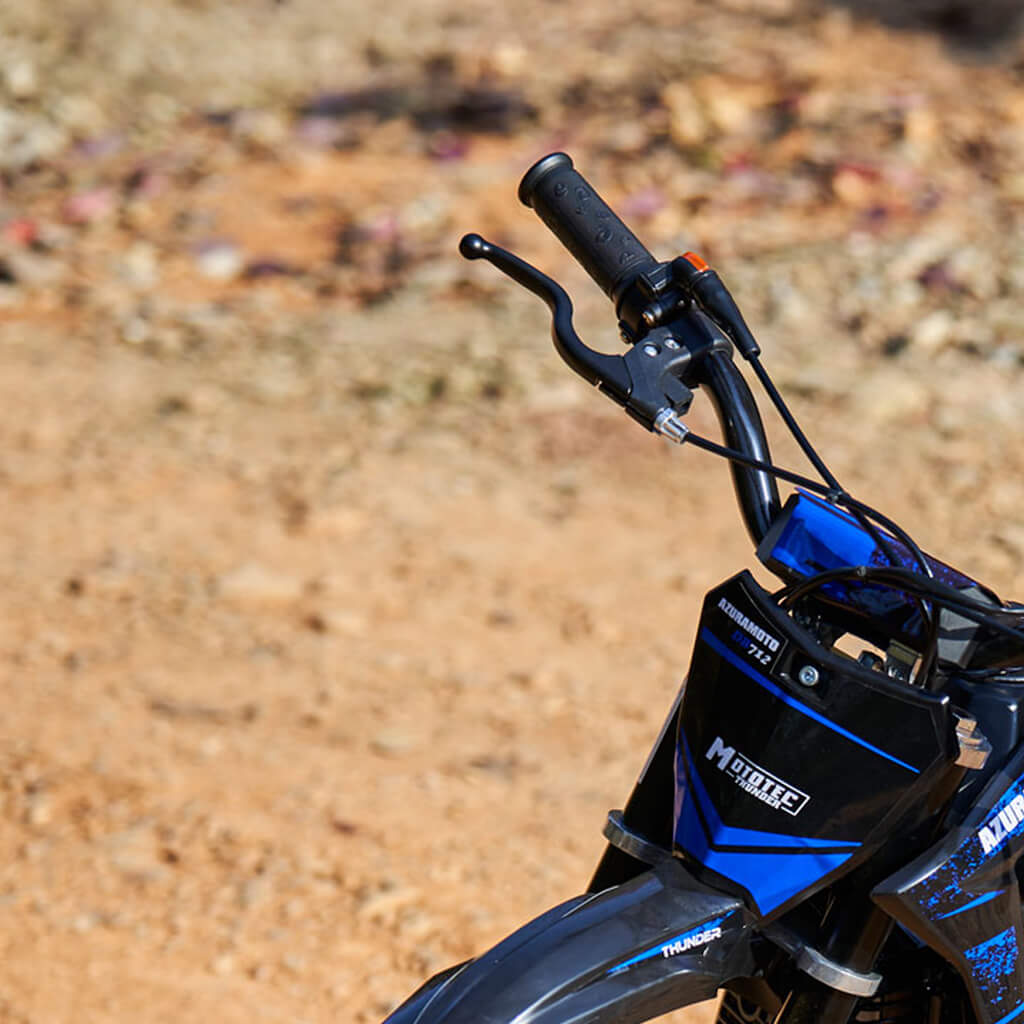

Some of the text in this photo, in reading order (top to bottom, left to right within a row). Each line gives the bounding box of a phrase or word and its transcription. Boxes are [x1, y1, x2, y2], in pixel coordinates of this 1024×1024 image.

[717, 597, 780, 652] AZURAMOTO
[705, 736, 799, 808] MOTOTEC
[661, 927, 722, 958] THUNDER
